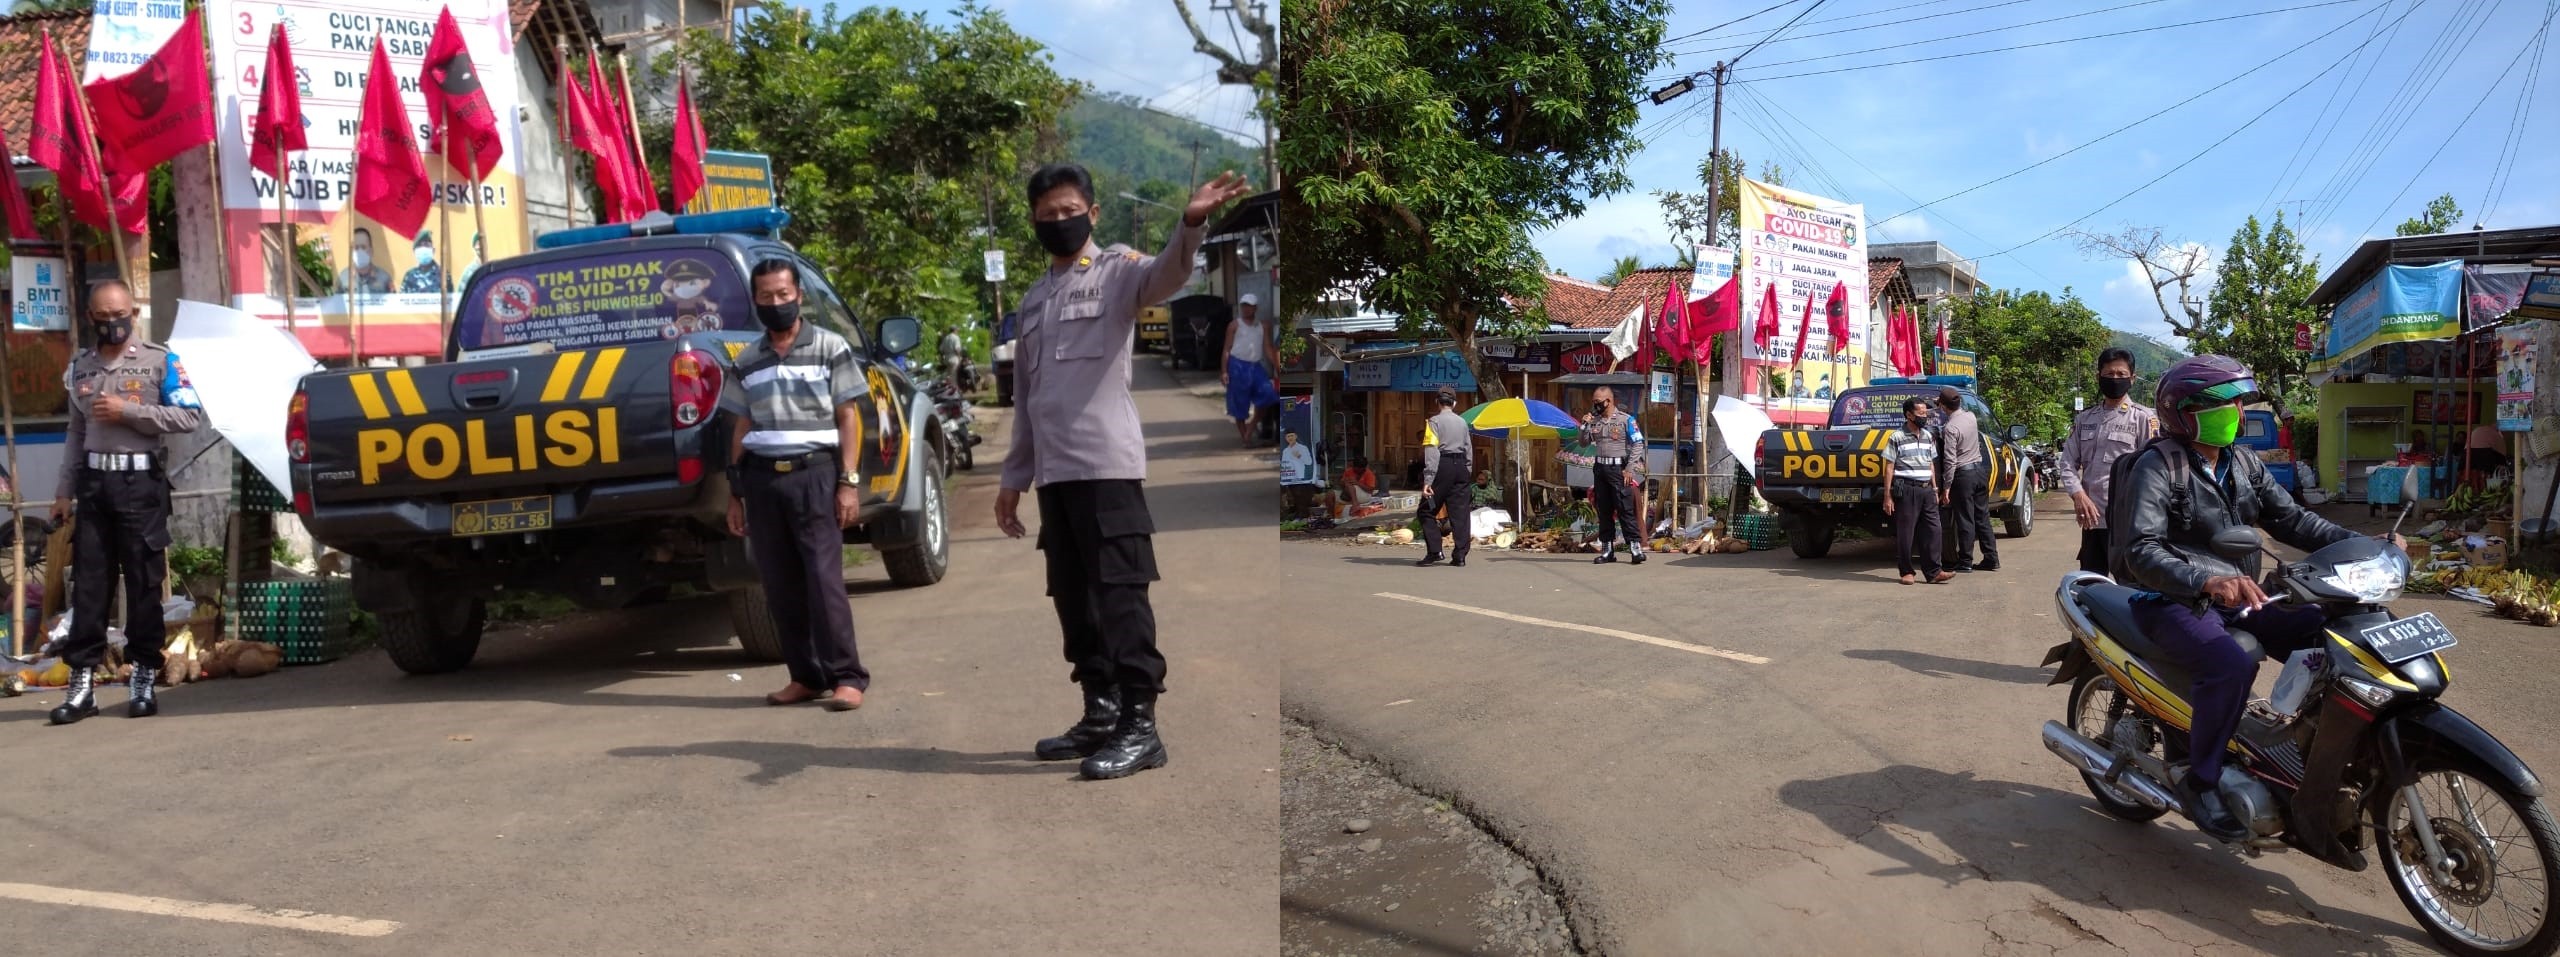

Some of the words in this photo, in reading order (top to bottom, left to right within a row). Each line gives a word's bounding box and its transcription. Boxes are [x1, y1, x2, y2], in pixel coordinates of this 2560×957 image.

[146, 3, 181, 19] STROKE
[239, 12, 254, 34] 3
[329, 12, 370, 32] CUCI
[375, 17, 437, 38] TANGA
[103, 51, 128, 63] 0823
[243, 64, 258, 88] 4
[334, 70, 353, 88] DI
[1787, 208, 1806, 220] AYO
[1809, 213, 1842, 227] CEGAH
[1771, 217, 1840, 244] COVID-19
[1754, 236, 1761, 245] 1
[1793, 243, 1815, 255] PAKAI
[1818, 249, 1847, 260] MASKER
[536, 271, 574, 287] TIM
[580, 261, 662, 282] TINDAK
[1754, 256, 1761, 266] 2
[1792, 264, 1811, 273] JAGA
[1814, 266, 1836, 278] JARAK
[550, 277, 650, 301] COVID-19
[1754, 277, 1761, 287] 3
[1793, 280, 1810, 289] CUCI
[1813, 282, 1835, 293] TANG
[1793, 289, 1815, 299] PAKI
[27, 288, 61, 302] BMT
[532, 301, 580, 318] POLRES
[584, 292, 663, 312] PURWOREJO
[1793, 304, 1800, 312] DI
[503, 323, 525, 333] AYO
[527, 320, 556, 330] PAKAI
[2391, 314, 2438, 325] DANDANG
[504, 332, 529, 343] JAGA
[566, 322, 606, 335] HINDARI
[607, 316, 673, 331] KERUMUNAN
[550, 336, 590, 347] TANGAN
[593, 332, 622, 343] PAKAI
[625, 328, 658, 340] SABUN
[1793, 324, 1825, 335] HIDARI
[121, 368, 151, 376] POLRI
[1409, 356, 1461, 380] PUAS
[358, 407, 619, 485] POLISI
[491, 515, 516, 531] 351
[528, 513, 546, 528] 56
[2369, 631, 2390, 648] AA
